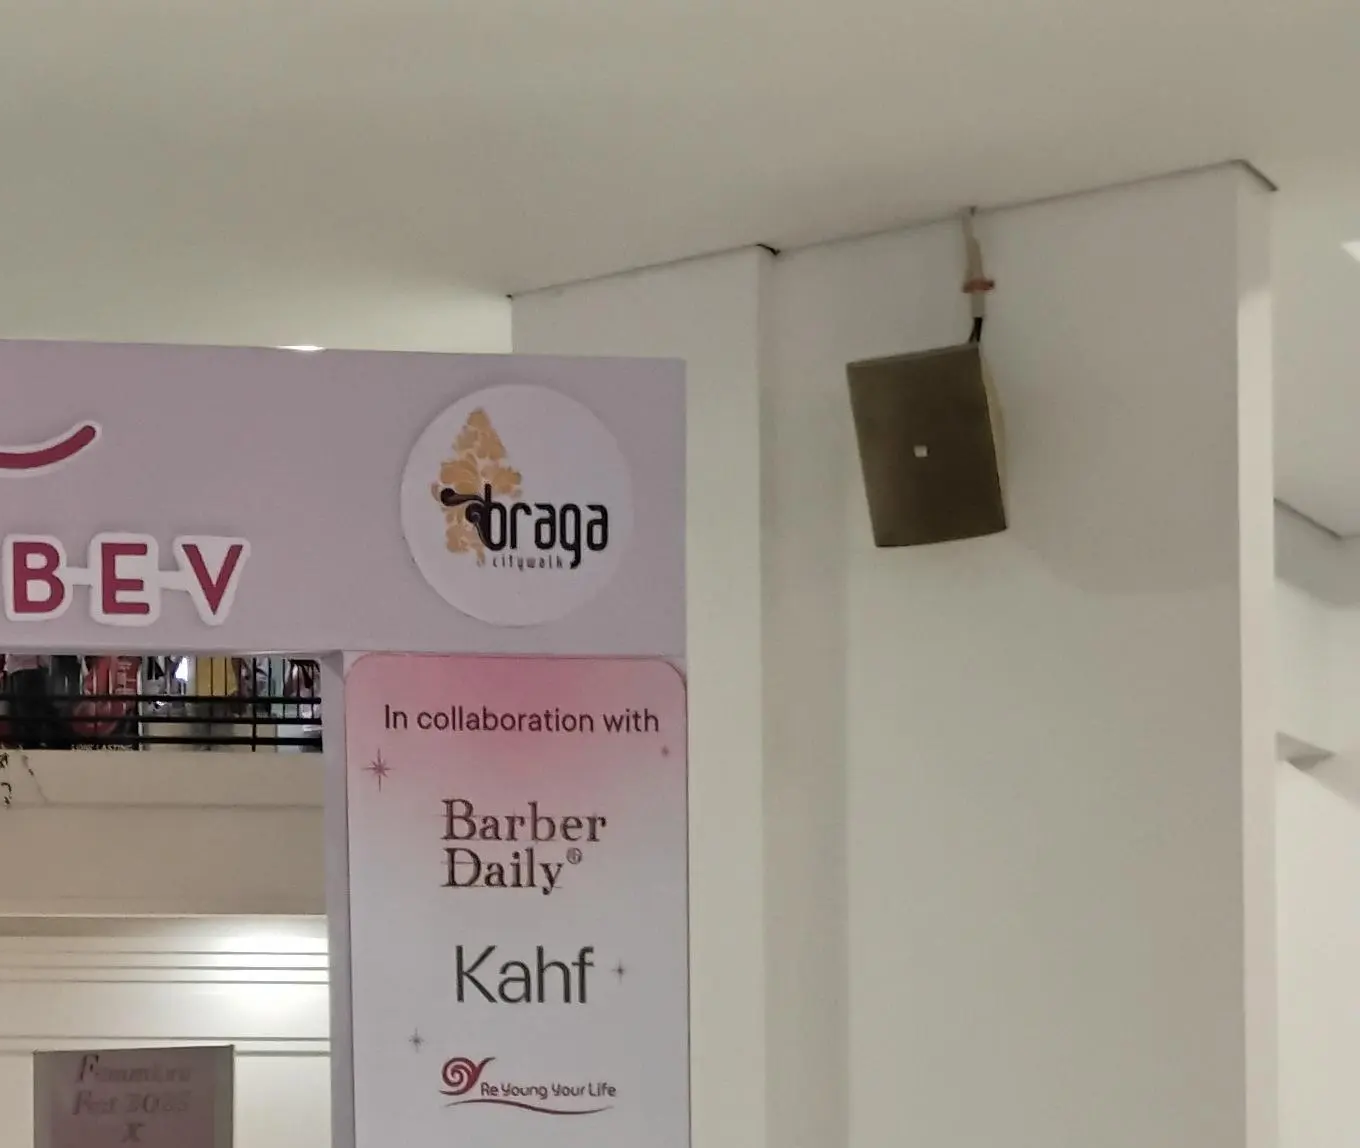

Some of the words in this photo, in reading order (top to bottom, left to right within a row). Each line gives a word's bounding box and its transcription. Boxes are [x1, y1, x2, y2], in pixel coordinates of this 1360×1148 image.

[464, 482, 609, 569] braga
[13, 540, 245, 615] BEV
[491, 554, 564, 571] citywalk
[384, 704, 408, 730] In
[416, 705, 594, 733] collaboration
[602, 708, 660, 733] with
[440, 797, 608, 844] Barber
[454, 944, 595, 1004] Kahf
